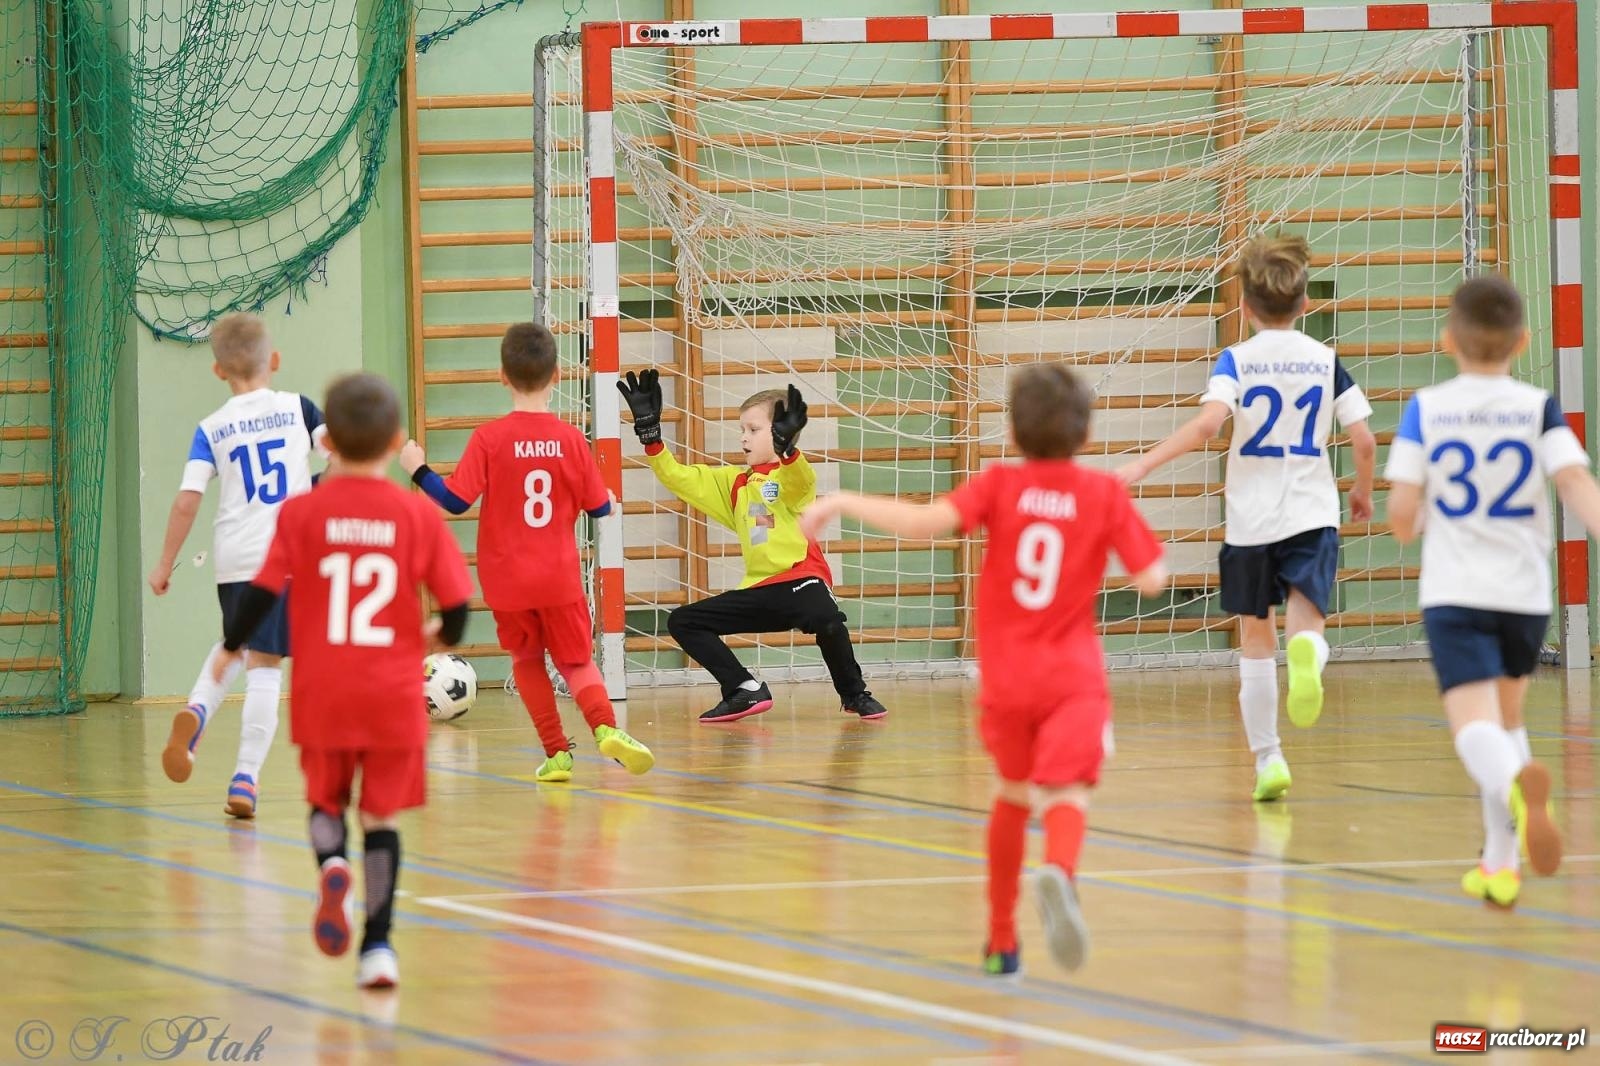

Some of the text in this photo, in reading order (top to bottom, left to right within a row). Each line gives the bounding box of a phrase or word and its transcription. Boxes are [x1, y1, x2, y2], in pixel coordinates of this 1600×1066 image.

[681, 26, 720, 41] sport
[1242, 363, 1270, 375] UNIA
[212, 412, 296, 444] UNIA RACIBÓRZ
[514, 440, 564, 458] KAROL
[1240, 385, 1323, 457] 21
[229, 438, 288, 505] 15
[523, 469, 553, 528] 8
[1430, 439, 1535, 517] 32
[1011, 522, 1065, 611] 9
[318, 551, 399, 648] 12
